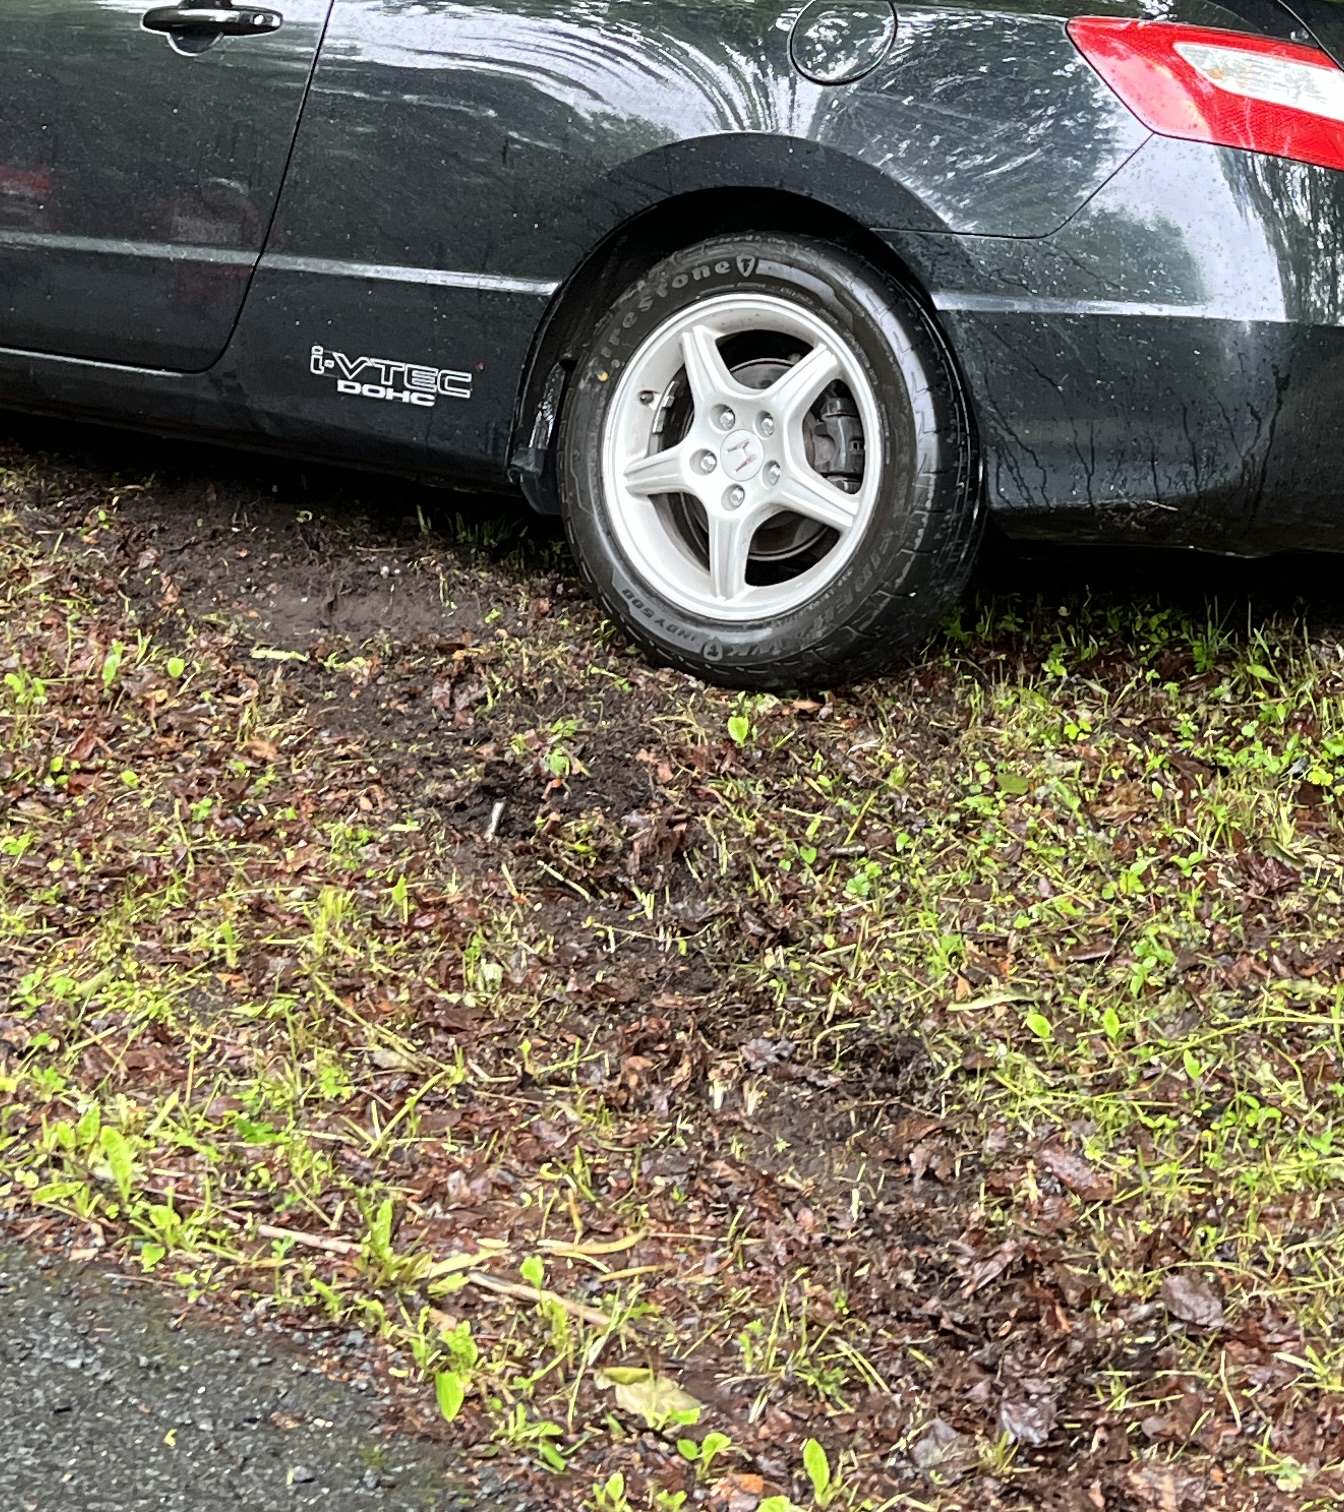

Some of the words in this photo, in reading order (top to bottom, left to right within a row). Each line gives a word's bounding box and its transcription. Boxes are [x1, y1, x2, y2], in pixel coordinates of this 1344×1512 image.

[592, 260, 731, 372] irestone
[310, 345, 472, 398] i-VTEC
[337, 379, 435, 407] DOHC
[621, 588, 655, 618] 500
[654, 618, 696, 642] INDY
